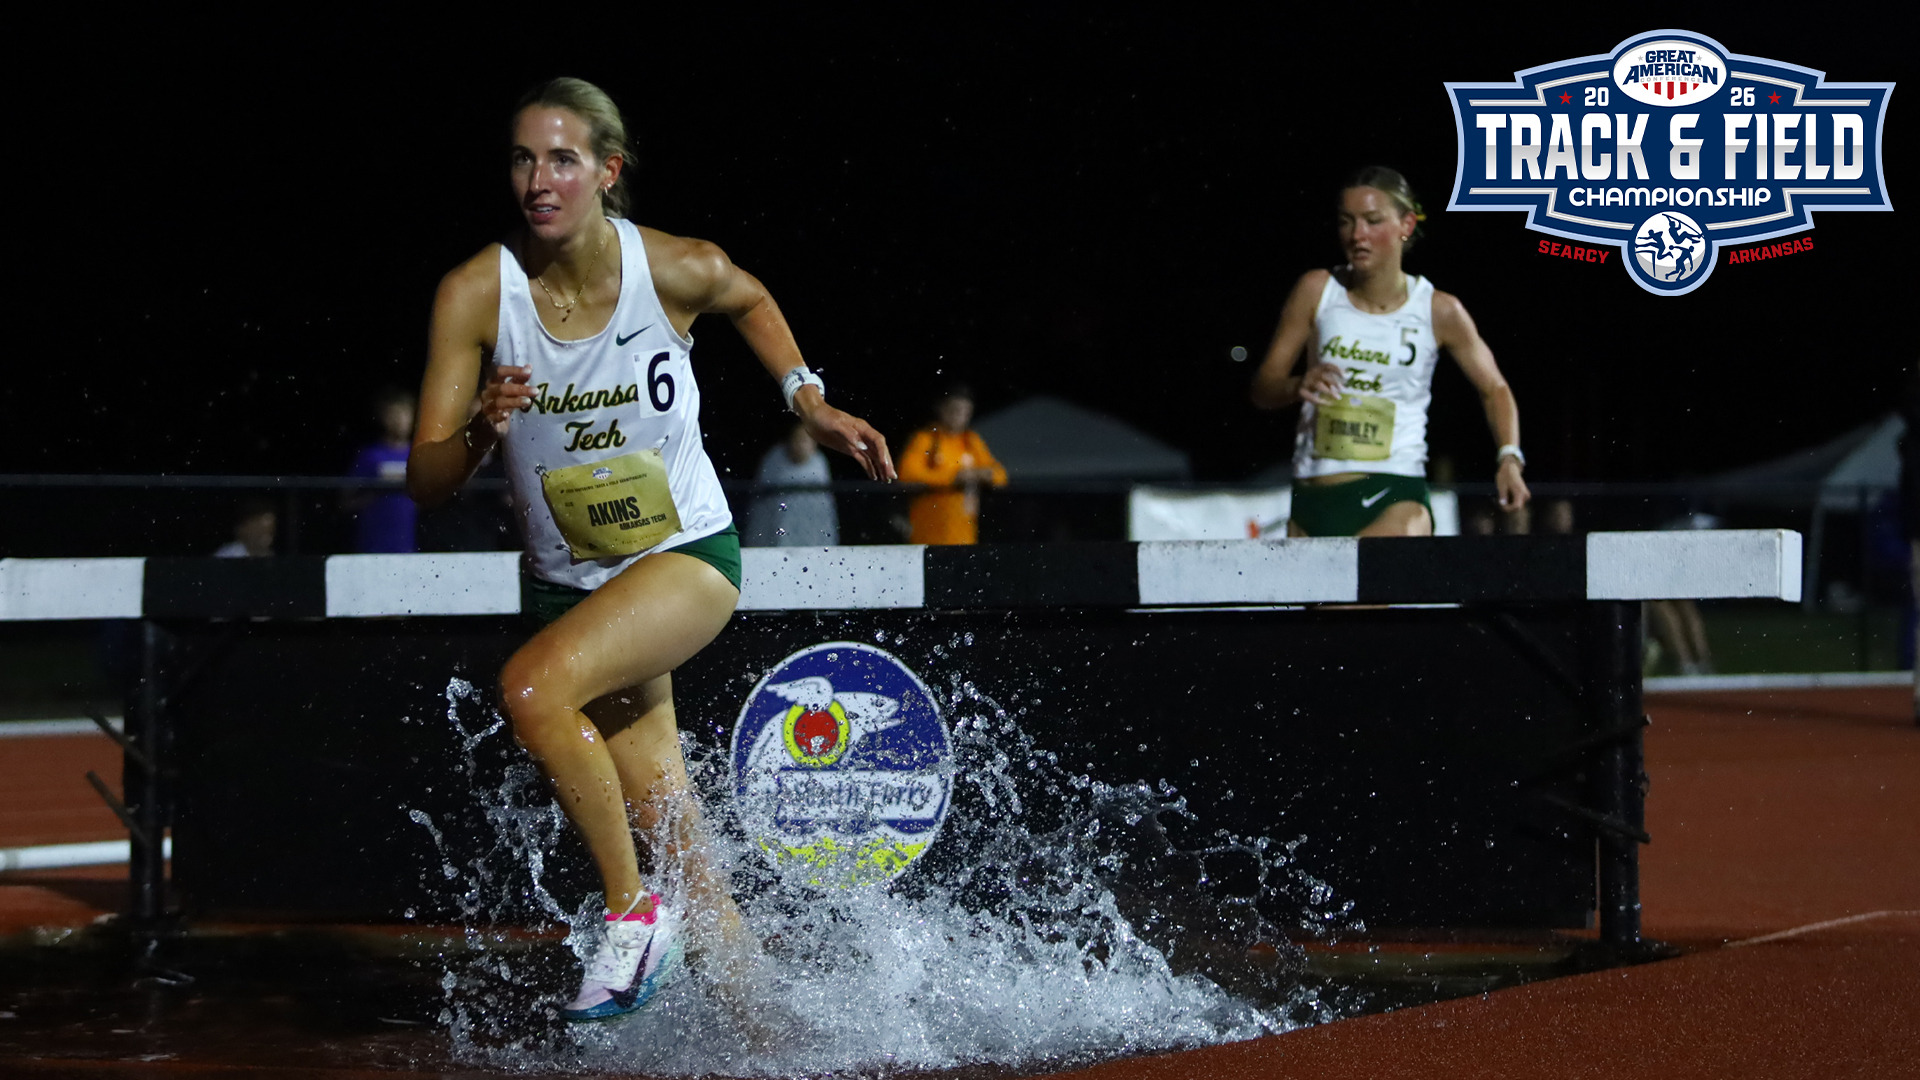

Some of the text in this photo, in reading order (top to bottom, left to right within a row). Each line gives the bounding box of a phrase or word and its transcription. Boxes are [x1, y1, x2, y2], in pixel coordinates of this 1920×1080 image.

[1321, 336, 1390, 365] Arkans
[1398, 327, 1418, 366] 5
[522, 382, 639, 415] Arkansa
[647, 351, 675, 413] 6
[564, 418, 627, 453] Tech
[587, 496, 641, 527] AKINS
[619, 513, 667, 531] ARKANSAS TECH
